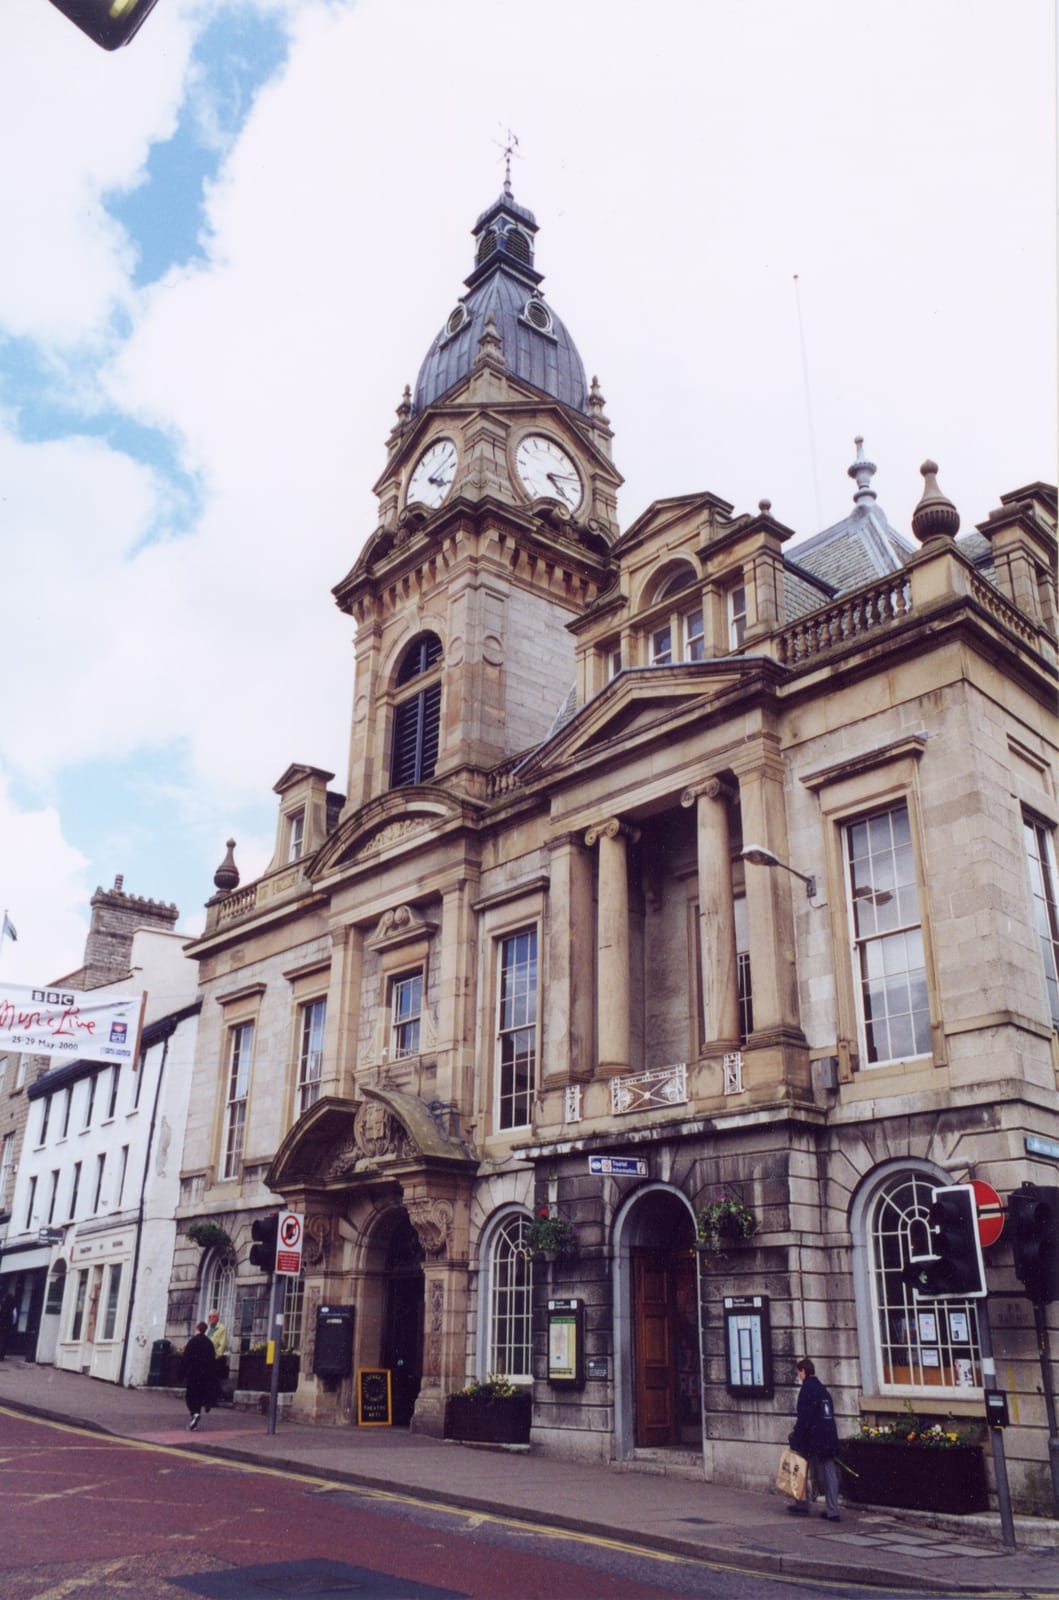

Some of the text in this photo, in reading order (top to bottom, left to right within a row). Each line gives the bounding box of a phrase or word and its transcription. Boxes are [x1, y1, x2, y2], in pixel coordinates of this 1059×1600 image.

[32, 990, 74, 1006] BBC
[0, 1000, 54, 1032] Music
[38, 1039, 55, 1049] May
[59, 1042, 79, 1050] 2000
